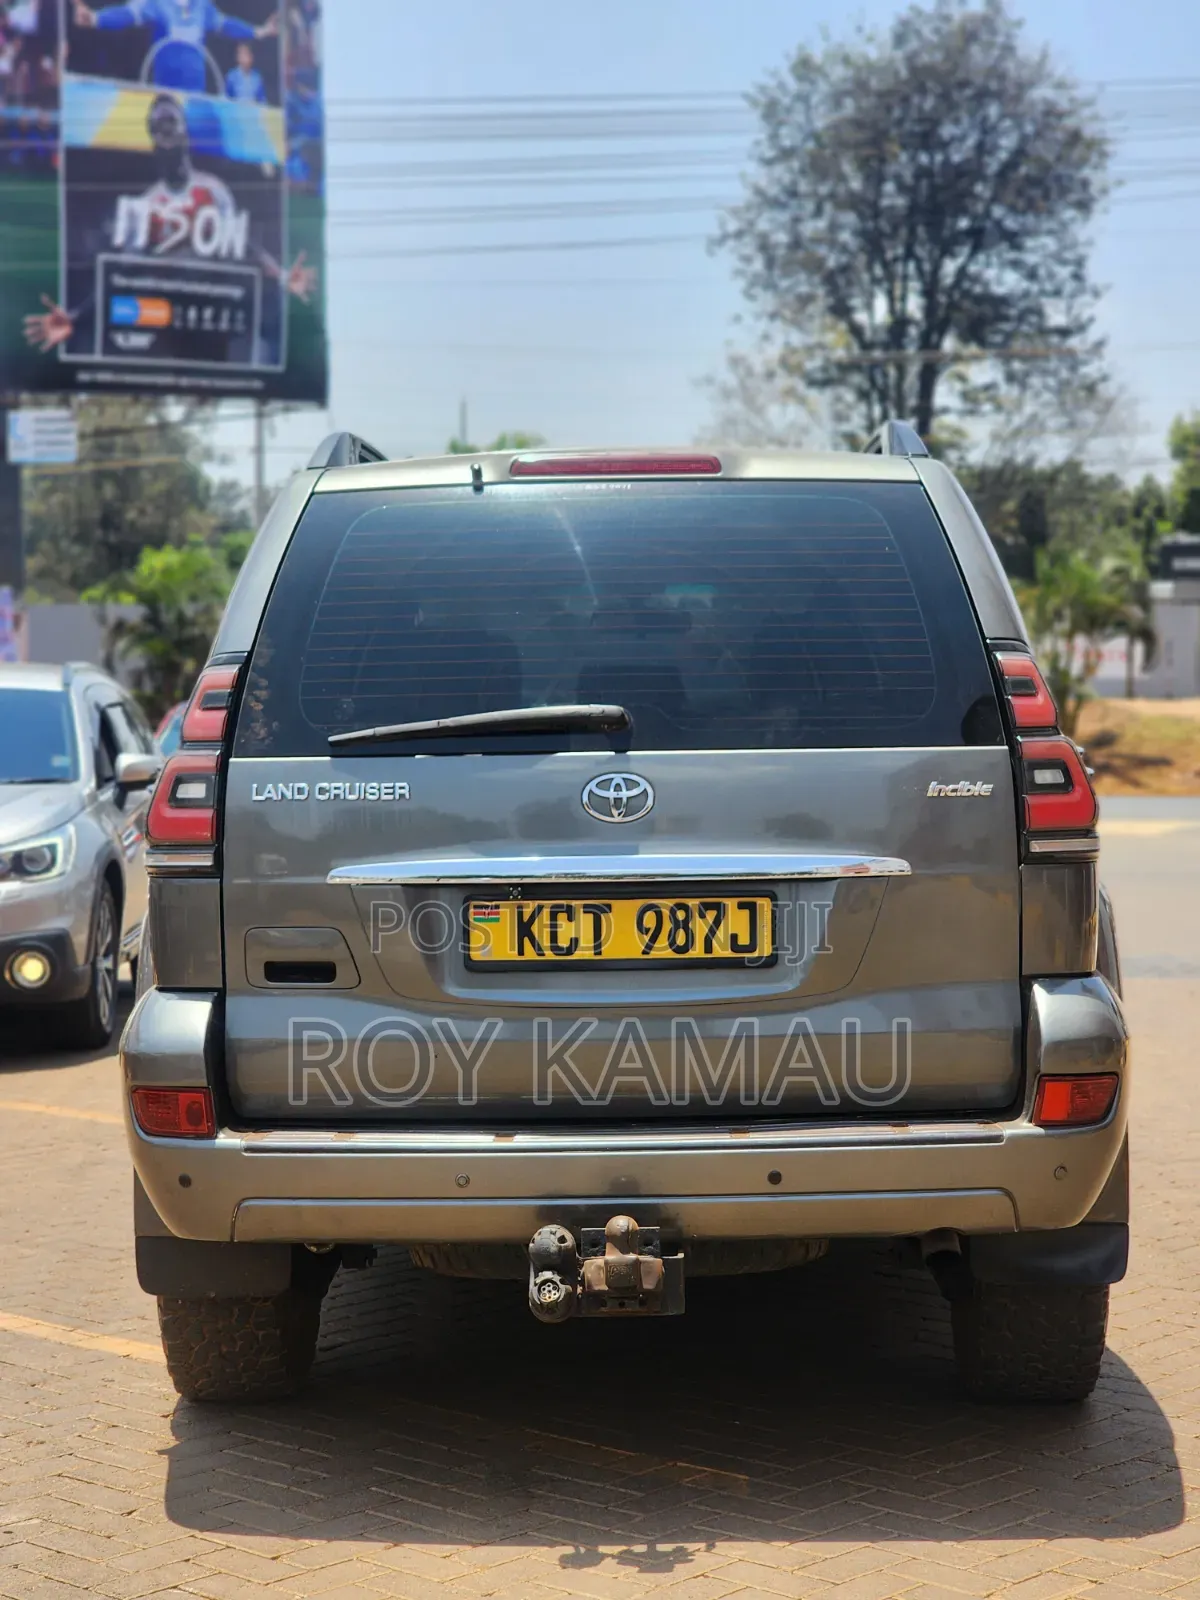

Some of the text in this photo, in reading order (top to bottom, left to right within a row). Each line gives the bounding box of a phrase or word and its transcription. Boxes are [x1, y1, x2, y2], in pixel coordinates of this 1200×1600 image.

[251, 782, 410, 801] LAND CRUISER
[515, 903, 612, 957] KCT
[635, 901, 758, 956] 987J
